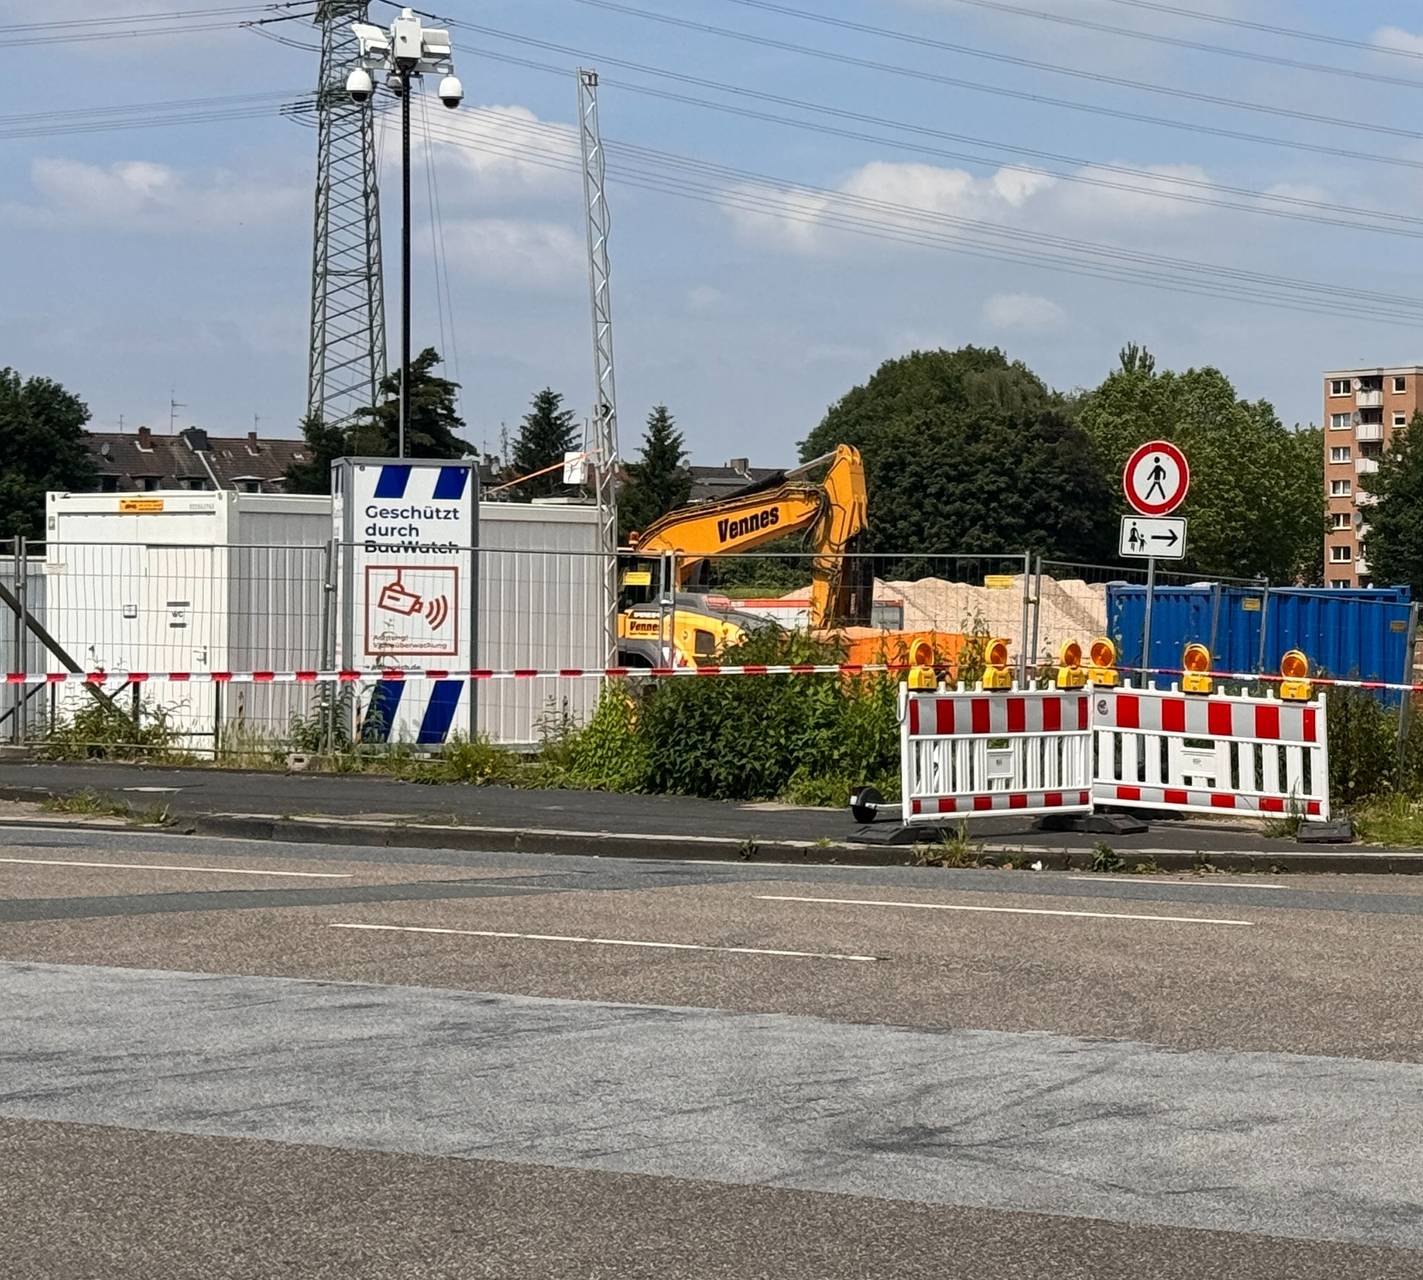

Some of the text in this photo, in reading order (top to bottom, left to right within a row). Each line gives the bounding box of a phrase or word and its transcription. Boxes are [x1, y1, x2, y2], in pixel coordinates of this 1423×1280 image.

[365, 505, 460, 520] Geschützt
[365, 523, 419, 537] durch
[717, 506, 780, 543] Vennes
[365, 540, 460, 554] BauWatch
[629, 621, 660, 632] Venne
